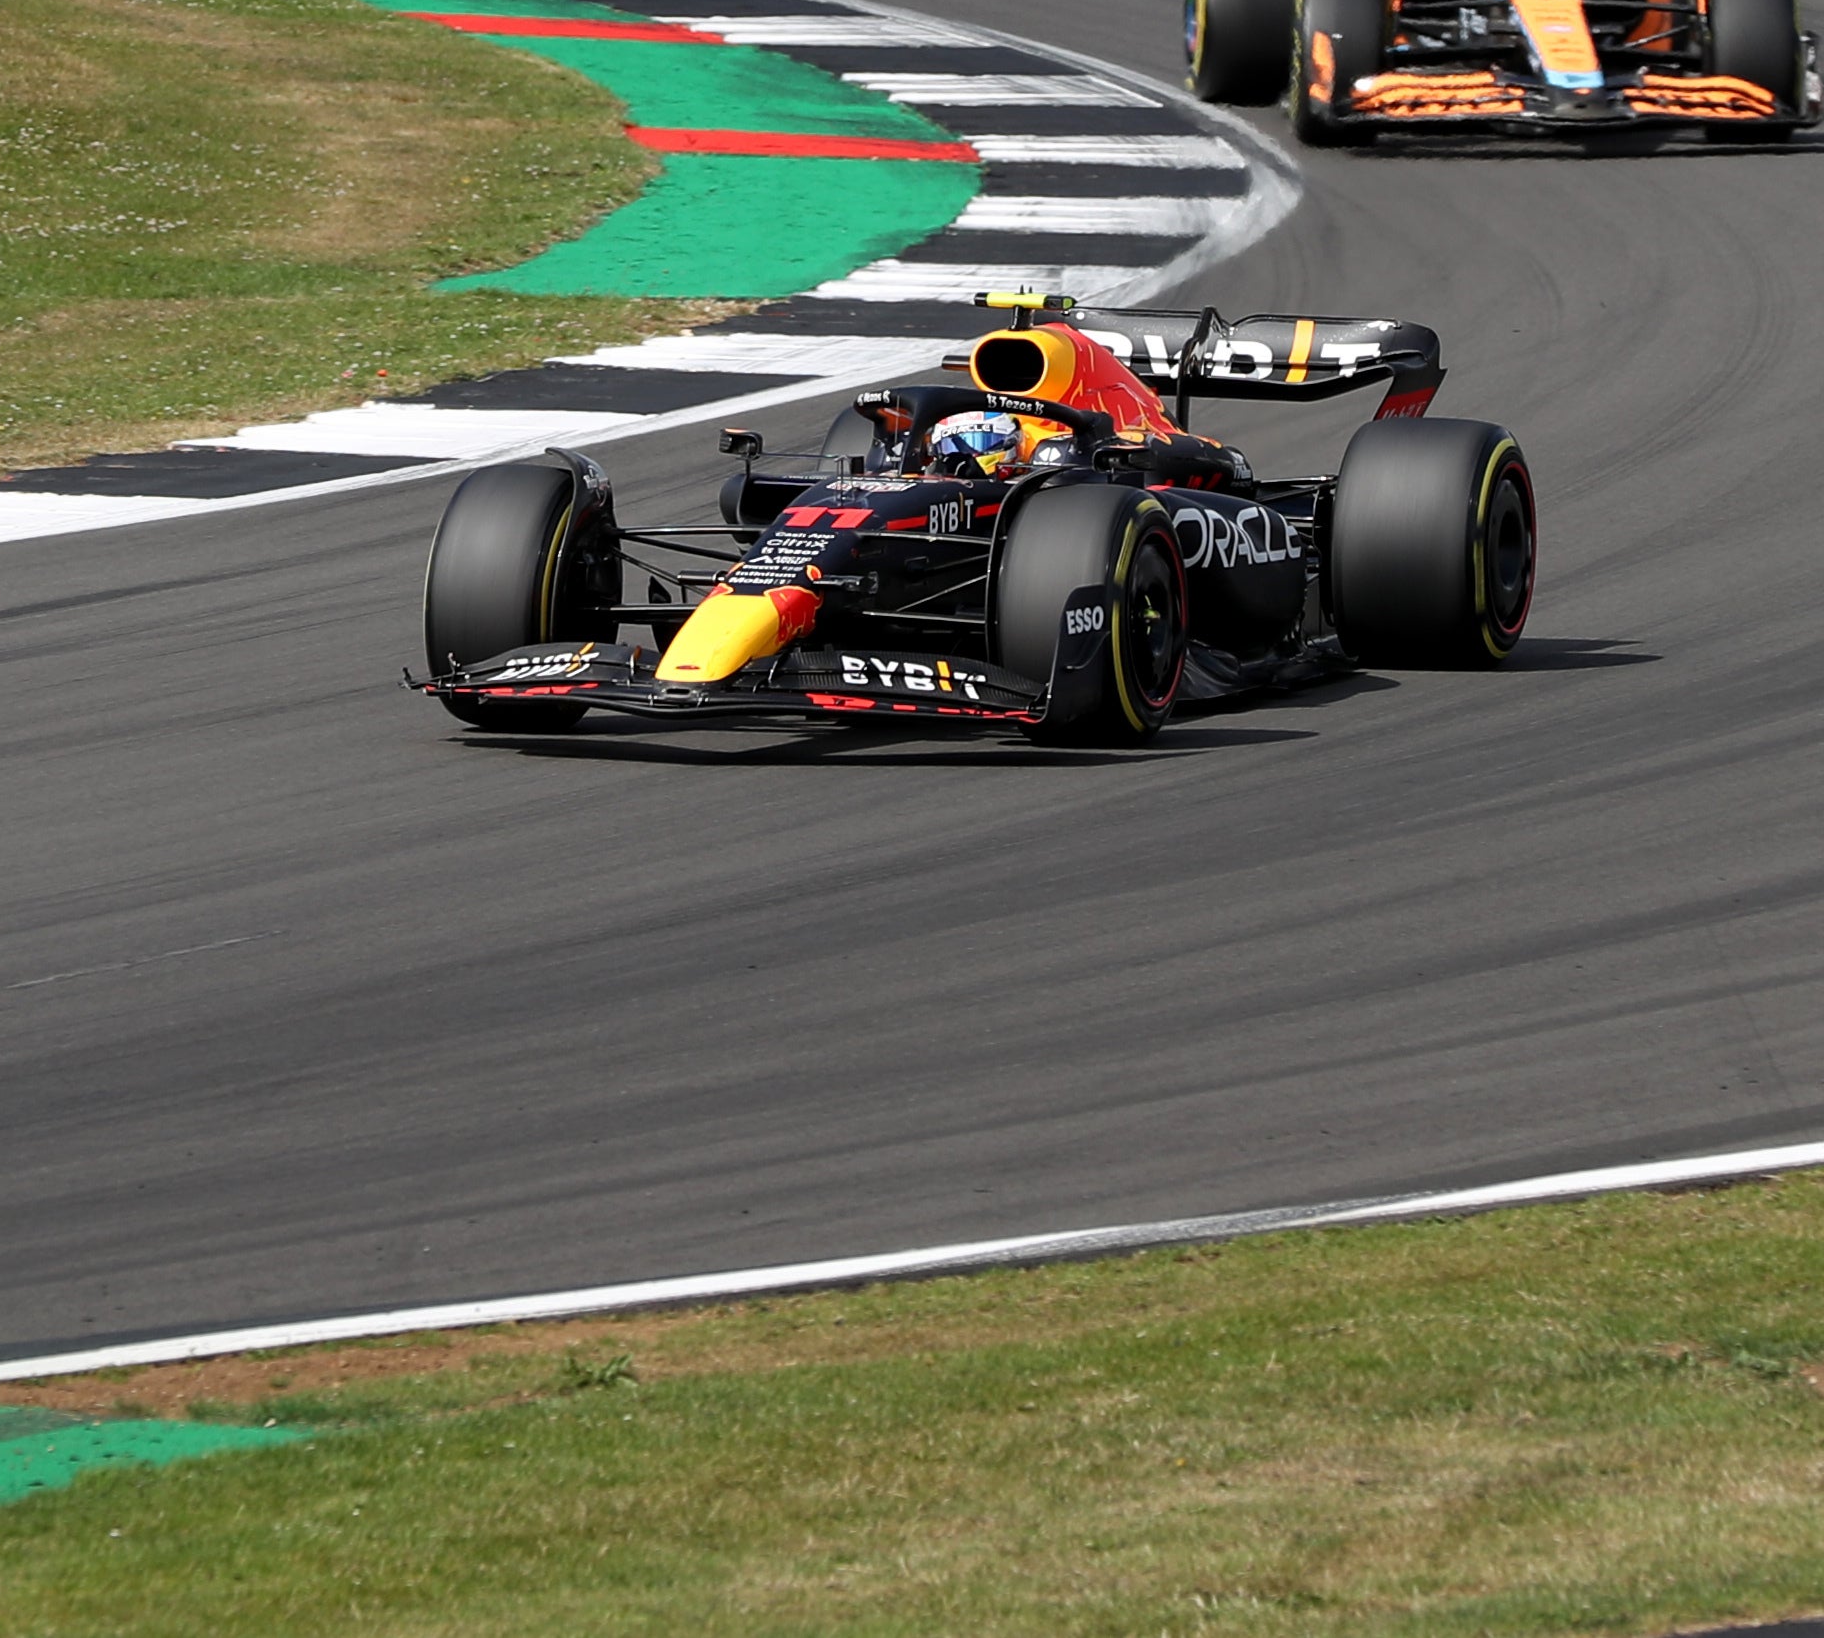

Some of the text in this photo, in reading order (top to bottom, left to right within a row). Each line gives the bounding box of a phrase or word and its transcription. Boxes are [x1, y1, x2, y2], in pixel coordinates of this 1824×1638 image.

[998, 396, 1034, 412] Tezos
[783, 506, 874, 529] 11
[929, 492, 974, 534] BYBIT
[766, 539, 828, 551] Citrix
[1173, 507, 1302, 568] ORACLE
[1066, 605, 1104, 634] ESSO
[841, 654, 986, 700] BYBIT
